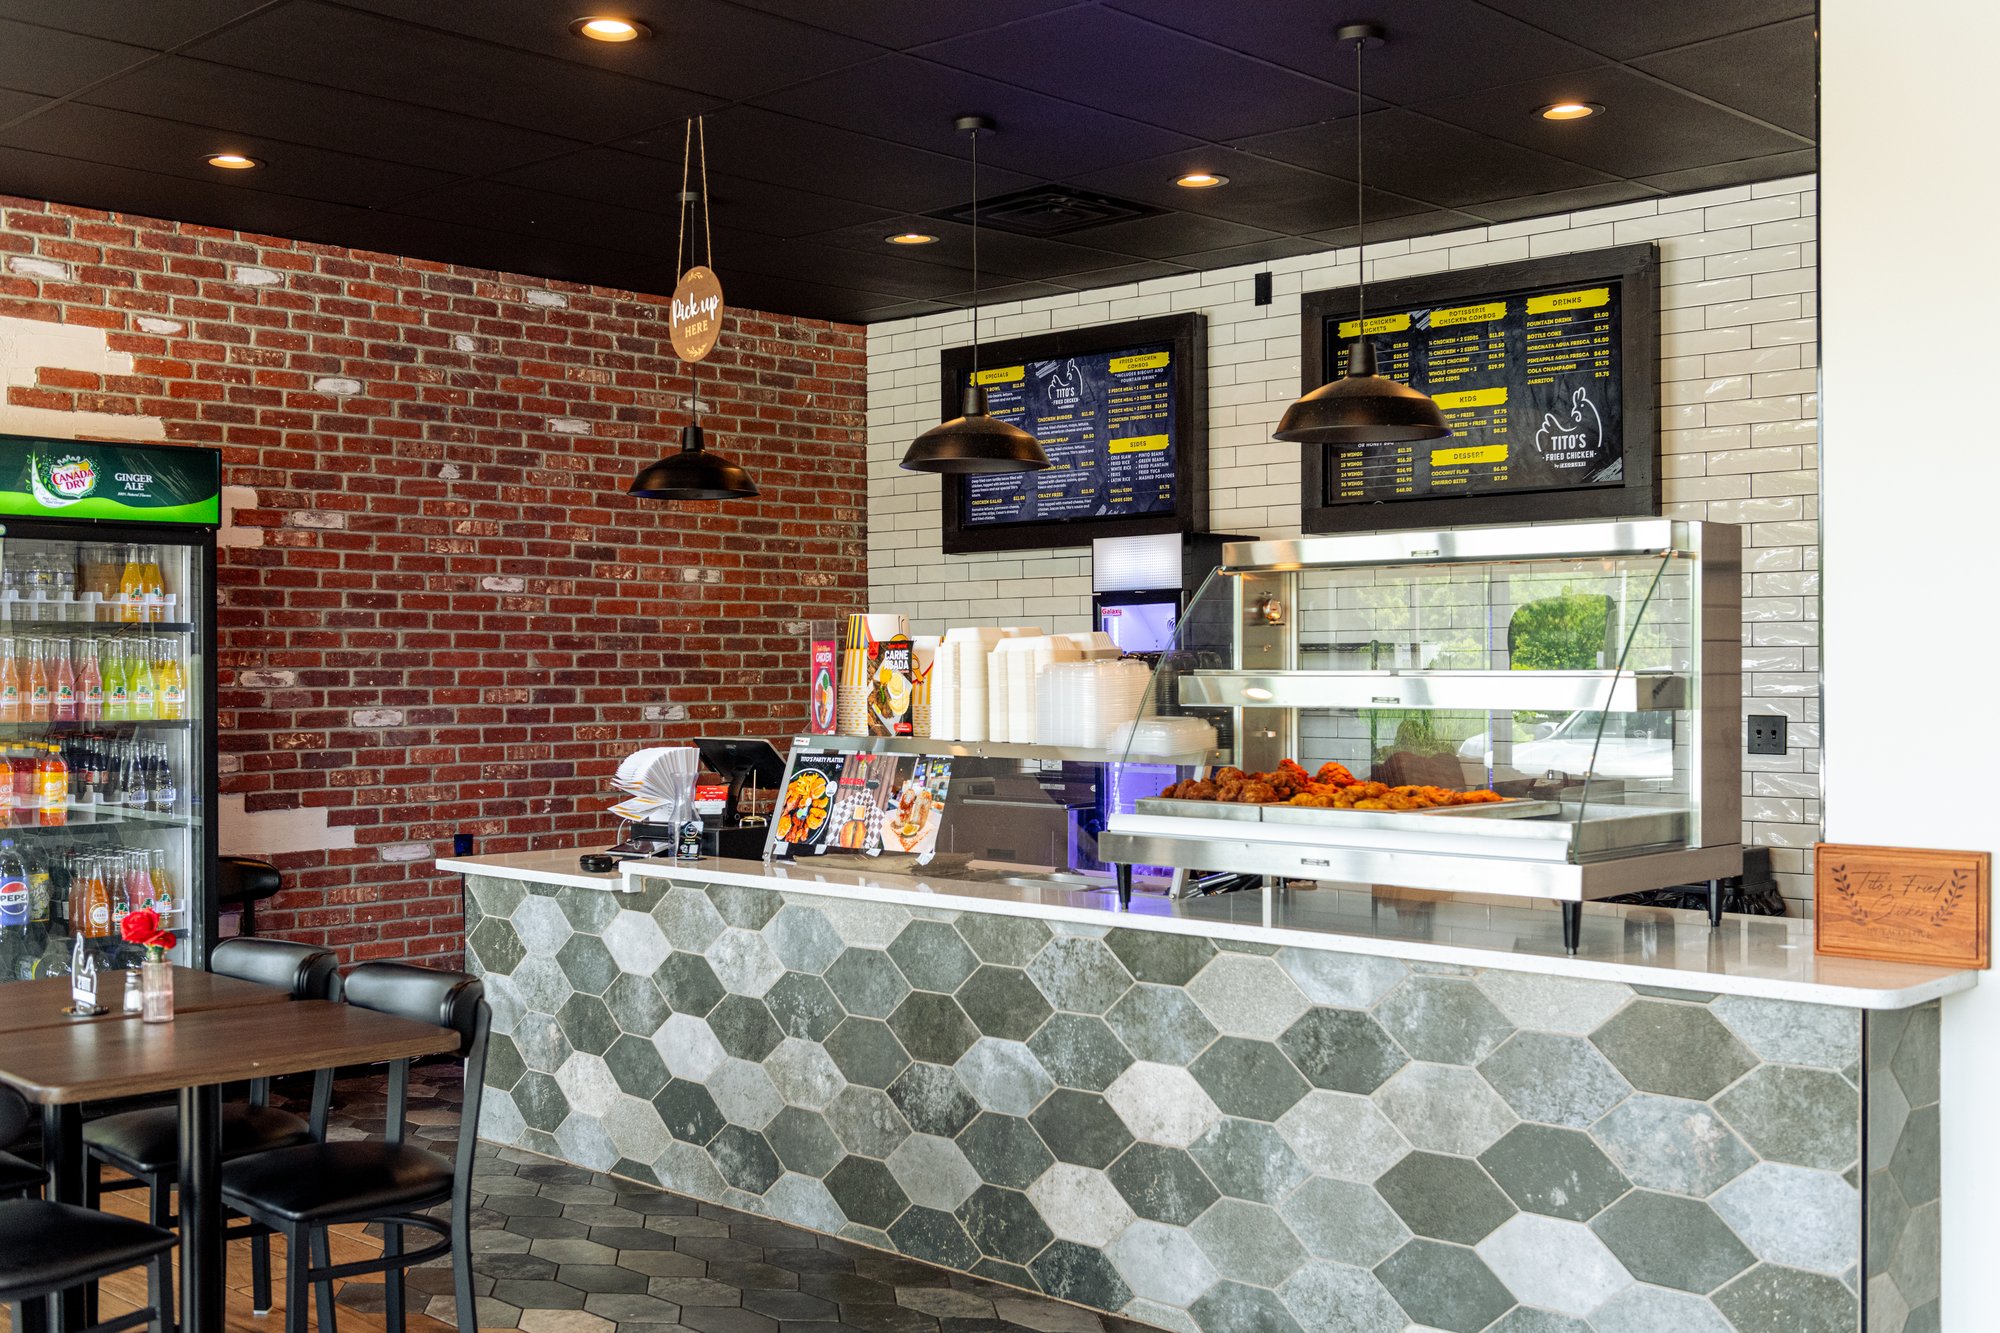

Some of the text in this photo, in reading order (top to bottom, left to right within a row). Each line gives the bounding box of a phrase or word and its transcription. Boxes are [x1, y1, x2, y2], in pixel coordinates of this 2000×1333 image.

[1553, 297, 1582, 306] DRINKS
[672, 292, 719, 328] Pick up
[1449, 307, 1485, 316] ROTISSERIE
[685, 320, 708, 338] HERE
[1543, 364, 1576, 372] CHAMPAGNE
[1056, 387, 1074, 398] TITO'S
[1551, 434, 1586, 450] TITO'S
[1546, 450, 1594, 461] FRIED CHICKEN
[52, 469, 95, 484] CANADA
[115, 472, 153, 483] GINGER
[66, 479, 86, 490] DRY
[885, 650, 908, 659] CARNE
[884, 660, 909, 669] ASADA
[1851, 871, 1947, 900] Tito's Fried
[0, 894, 28, 902] PEPSI
